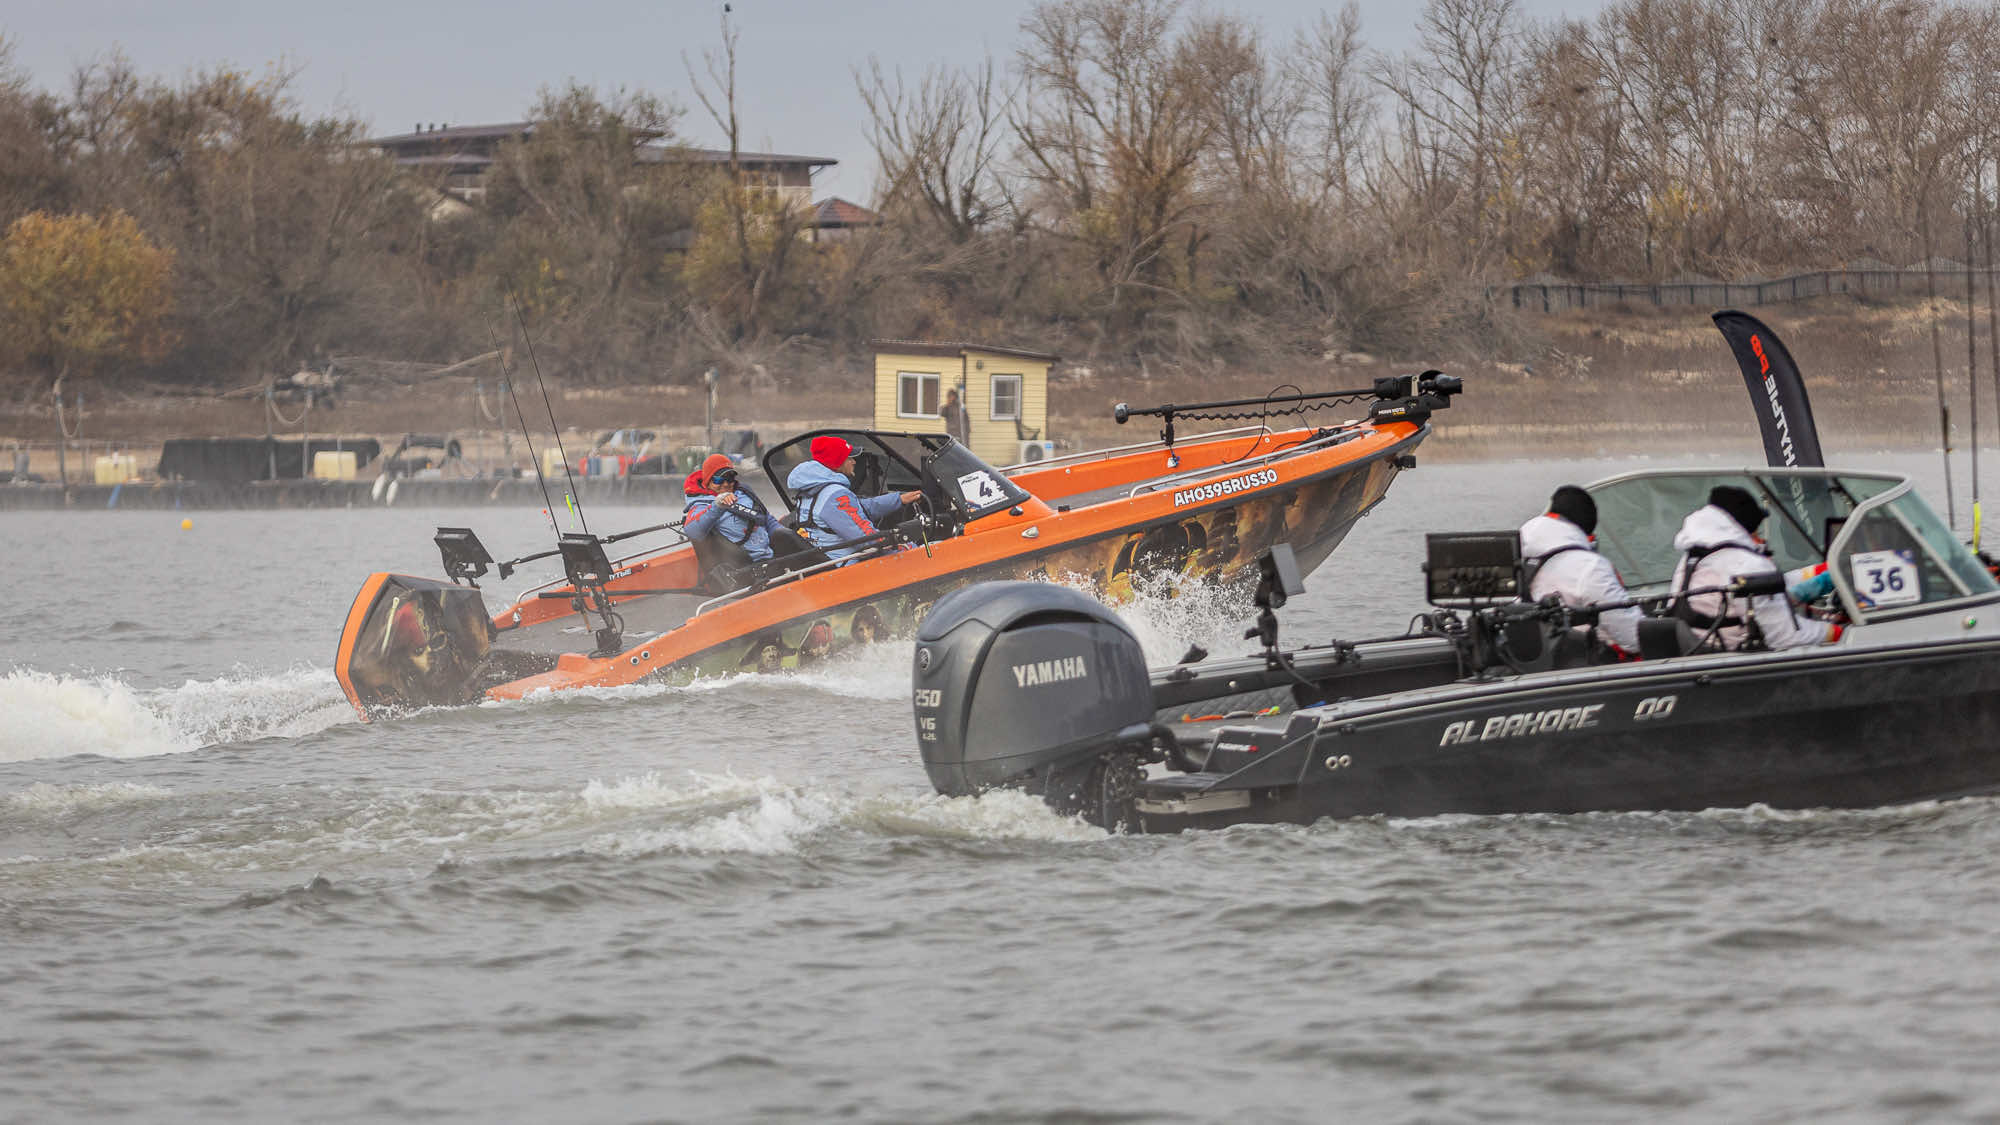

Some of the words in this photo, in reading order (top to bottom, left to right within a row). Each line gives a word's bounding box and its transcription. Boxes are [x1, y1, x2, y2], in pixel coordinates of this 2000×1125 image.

[979, 480, 993, 497] 4
[1867, 566, 1904, 594] 36
[1012, 655, 1087, 688] YAMAHA
[914, 688, 942, 707] 250
[919, 716, 937, 730] V6
